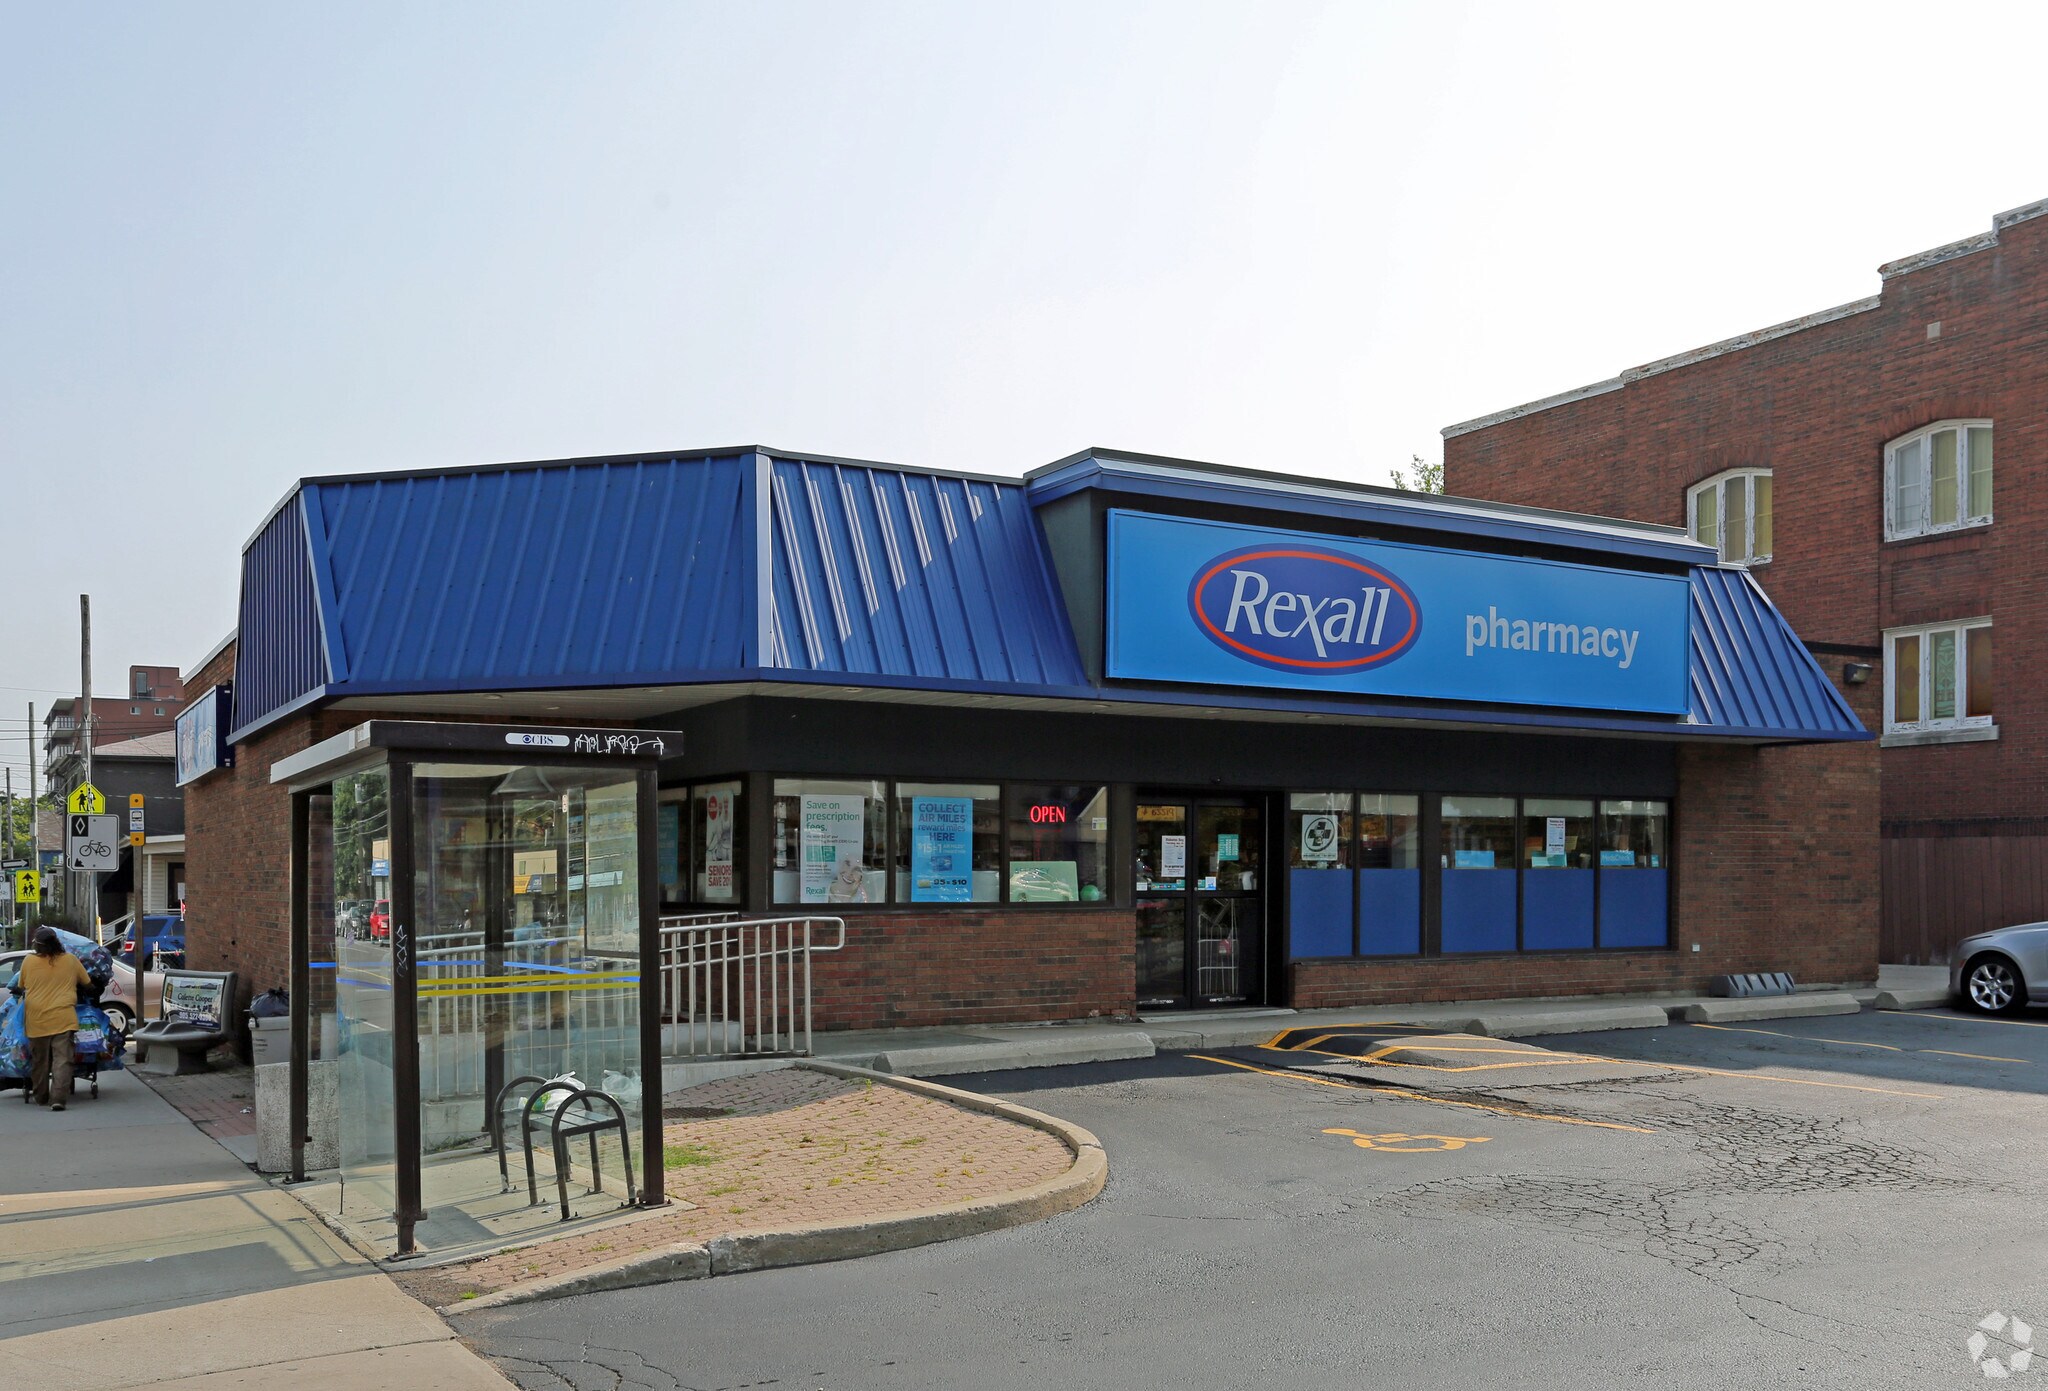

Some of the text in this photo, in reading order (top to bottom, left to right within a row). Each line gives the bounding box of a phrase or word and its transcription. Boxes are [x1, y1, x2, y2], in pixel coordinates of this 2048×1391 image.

[1225, 570, 1391, 658] Rexall
[1466, 606, 1639, 669] pharmacy
[531, 734, 554, 745] CBS
[806, 800, 827, 810] Save
[918, 803, 966, 814] COLLECT
[806, 812, 860, 823] prescription
[918, 814, 935, 823] AIR
[937, 814, 966, 823] MILES
[1029, 805, 1066, 823] OPEN
[806, 822, 828, 832] fees.
[918, 824, 965, 832] reward miles
[929, 833, 955, 841] HERE
[708, 865, 732, 876] SENIORS
[708, 877, 723, 887] SAVE
[195, 994, 213, 1004] Cooper
